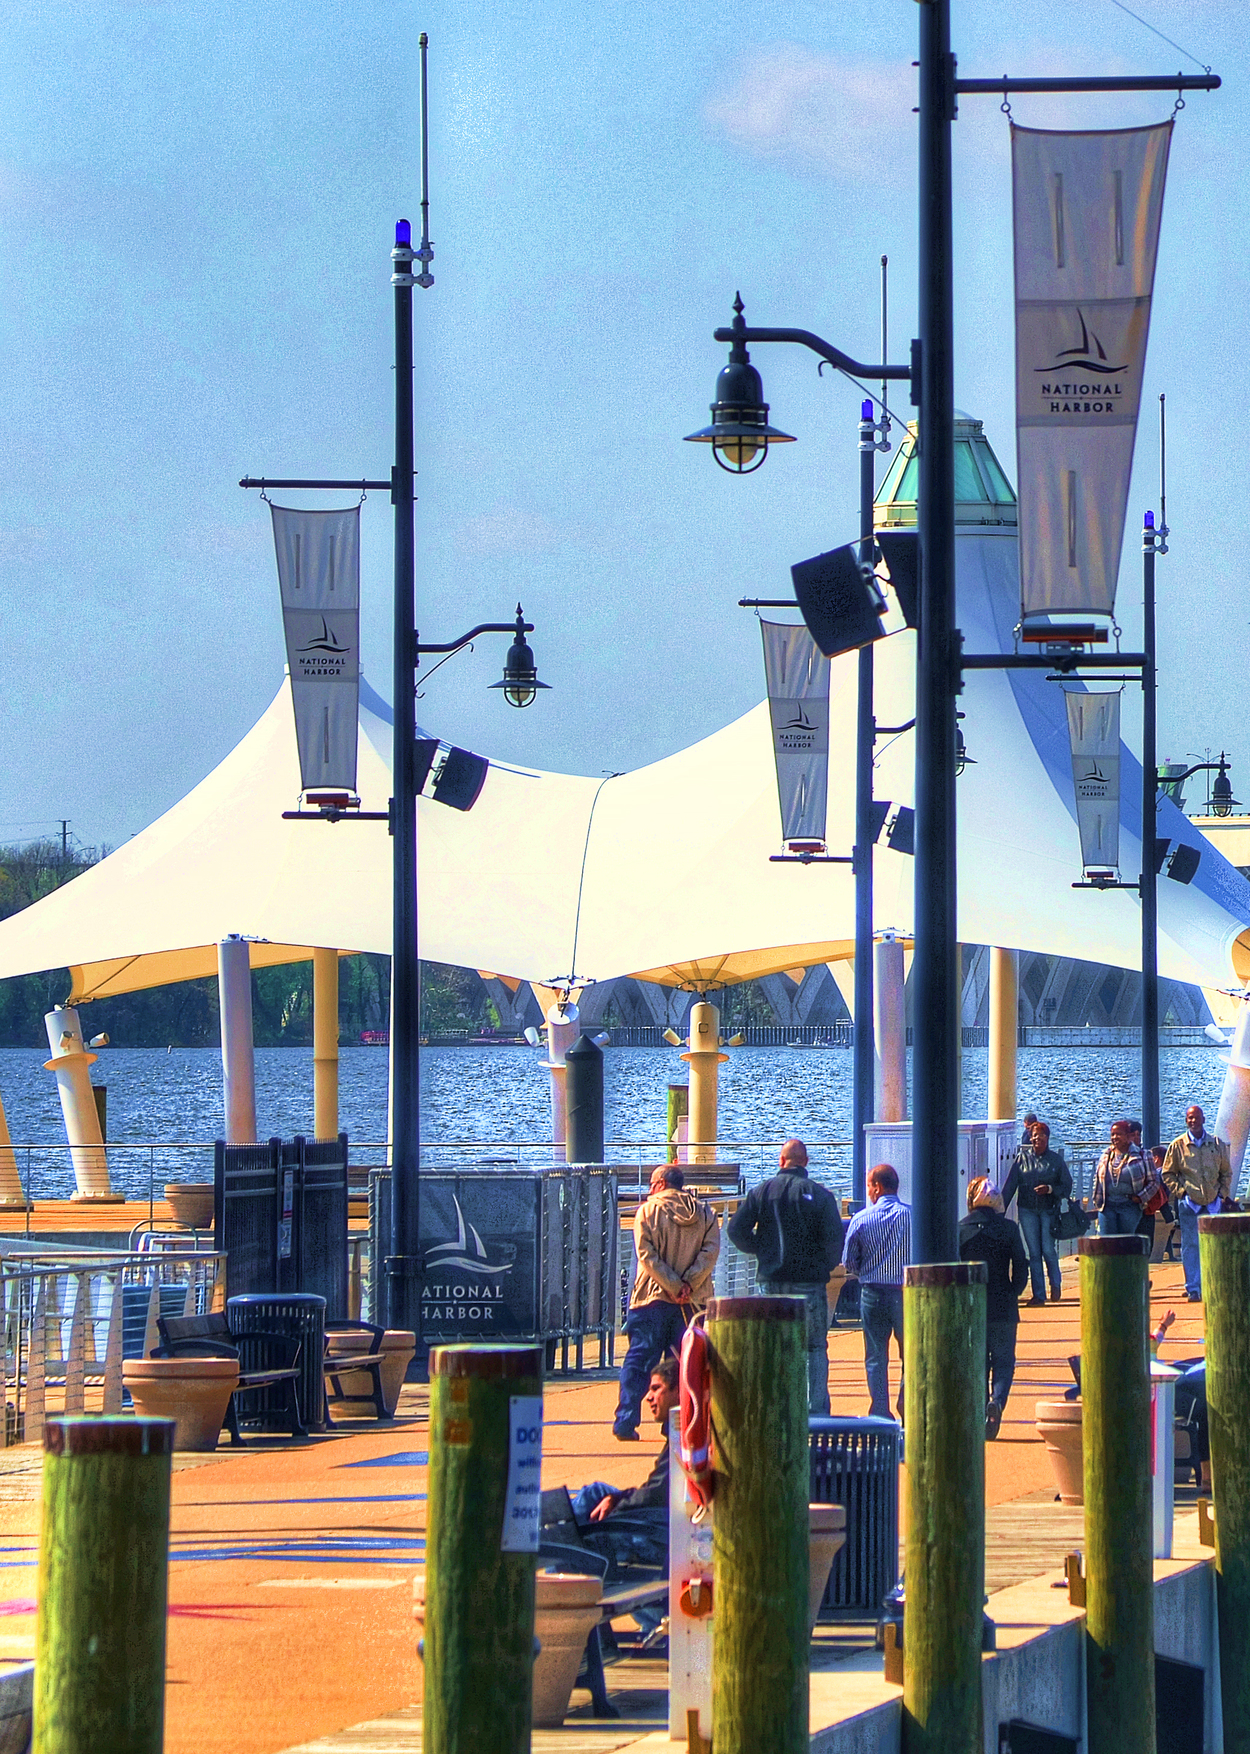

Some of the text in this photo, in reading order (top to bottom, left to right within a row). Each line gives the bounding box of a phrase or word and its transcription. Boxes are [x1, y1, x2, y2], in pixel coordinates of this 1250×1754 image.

[1042, 383, 1122, 395] NATIONAL
[1050, 402, 1113, 413] HARBOR
[421, 1285, 504, 1298] ATIONAL
[421, 1306, 494, 1319] HARBOR
